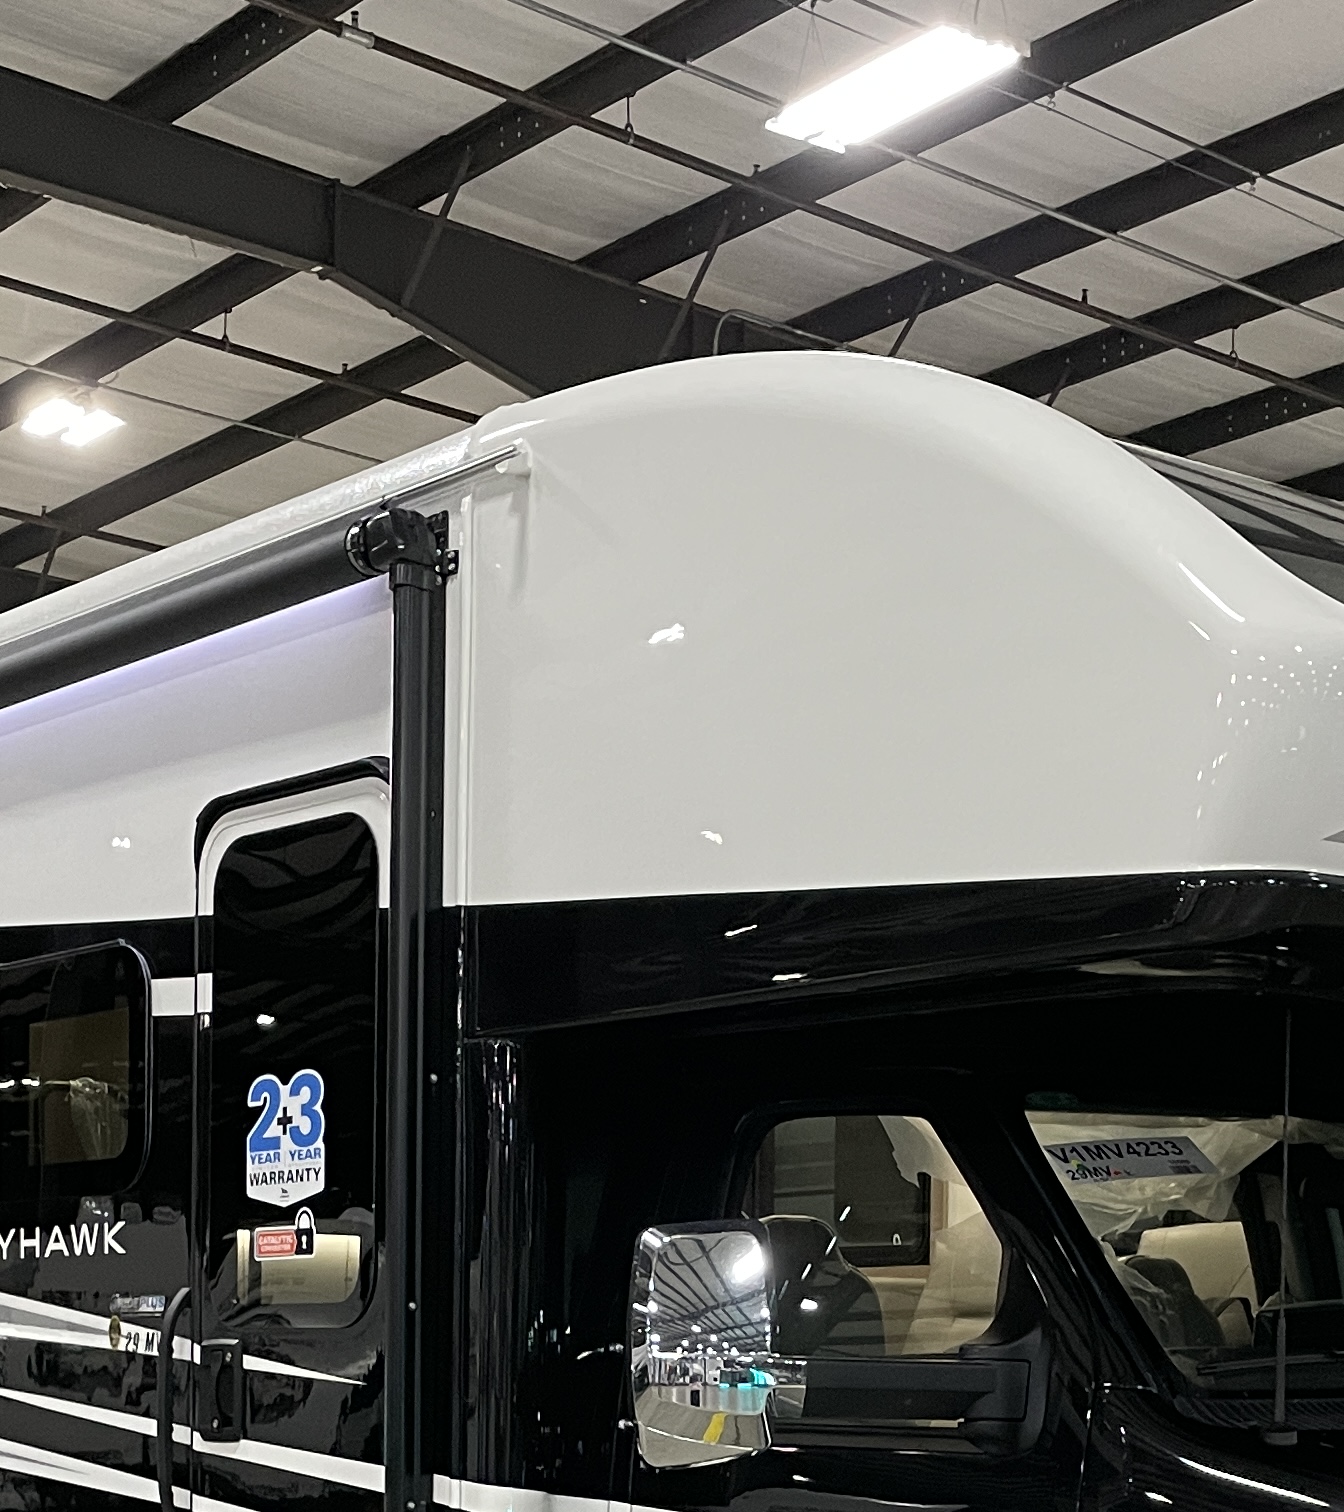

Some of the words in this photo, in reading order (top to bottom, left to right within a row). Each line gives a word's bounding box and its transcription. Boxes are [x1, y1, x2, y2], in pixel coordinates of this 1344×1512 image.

[250, 1151, 281, 1165] YEAR
[289, 1147, 322, 1161] YEAR
[1046, 1140, 1184, 1164] V1MV4233
[249, 1167, 322, 1187] WARRANTY
